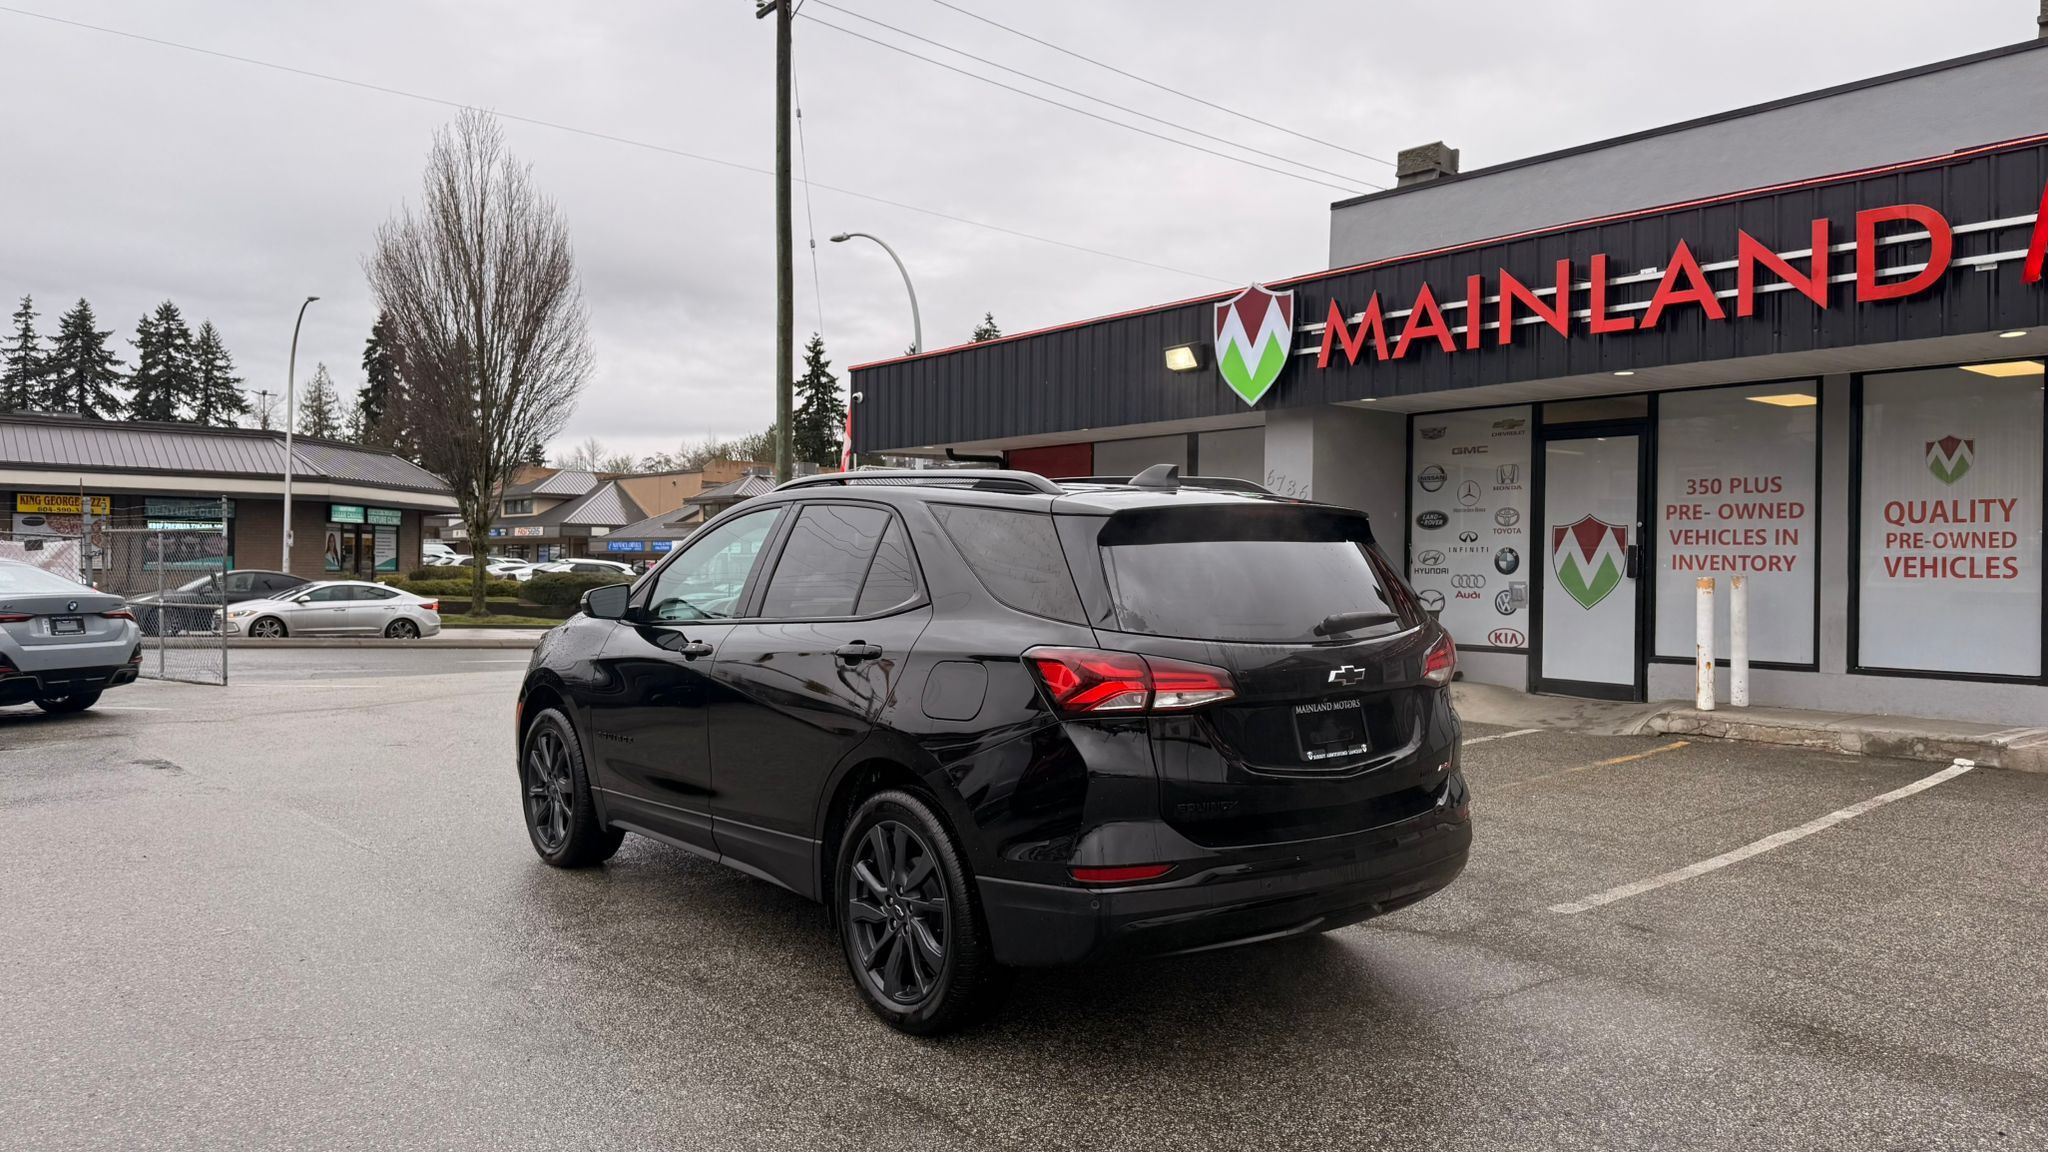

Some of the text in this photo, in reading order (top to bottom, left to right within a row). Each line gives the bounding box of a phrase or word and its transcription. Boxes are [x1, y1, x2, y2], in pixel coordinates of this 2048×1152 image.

[1317, 203, 1953, 369] MAINLAND
[1452, 445, 1488, 455] GMC
[1267, 469, 1309, 500] 6786
[1686, 476, 1782, 495] 350 PLUS
[20, 495, 42, 506] KING
[44, 495, 80, 507] GEORGE
[1666, 502, 1805, 520] PRE- OWNED
[1884, 498, 2018, 527] QUALITY
[1493, 527, 1521, 535] TOYOTA
[1669, 528, 1799, 545] VEHICLES IN
[1886, 531, 2018, 549] PRE-OWNED
[1414, 567, 1449, 575] HYUNDAI
[1672, 554, 1797, 572] INVENTORY
[1883, 556, 2019, 579] VEHICLES
[1455, 590, 1480, 599] Audi
[1494, 632, 1519, 645] KIA
[1296, 699, 1361, 714] MAINLAND MOTORS
